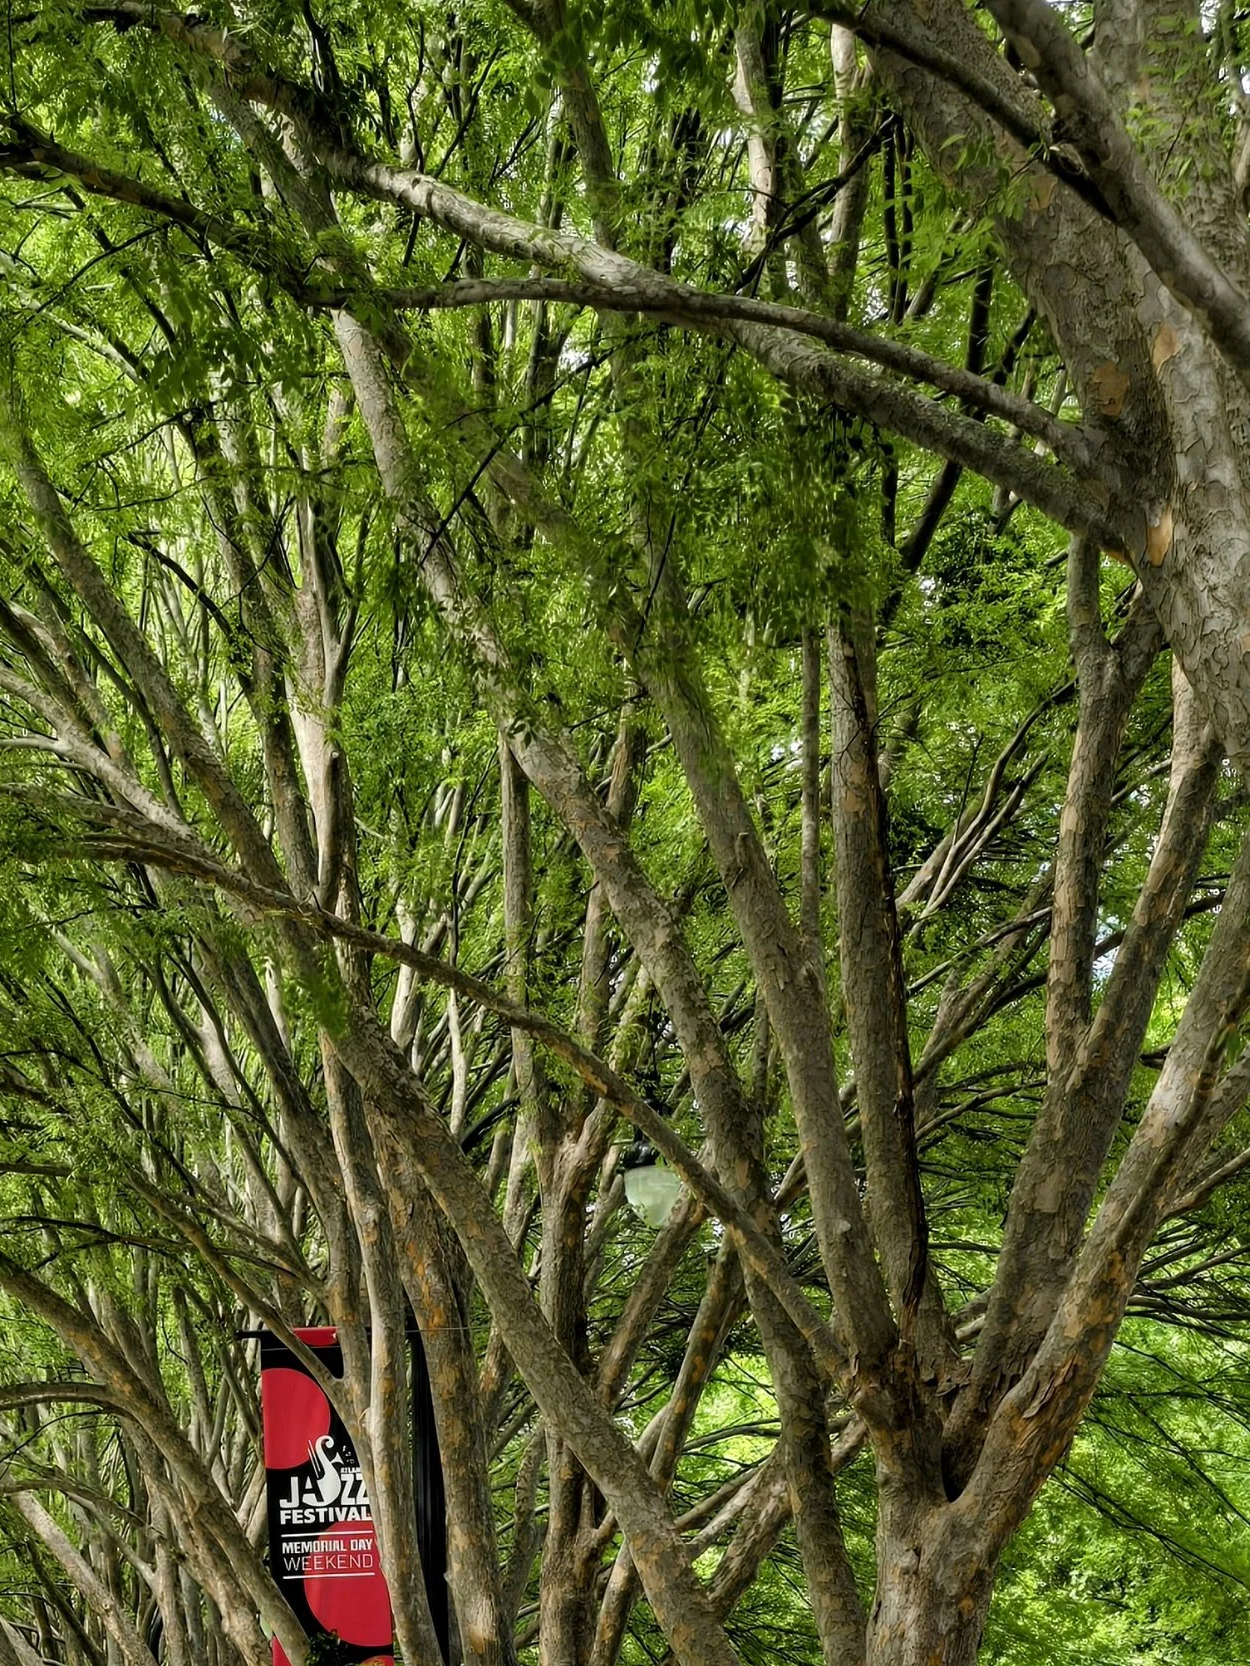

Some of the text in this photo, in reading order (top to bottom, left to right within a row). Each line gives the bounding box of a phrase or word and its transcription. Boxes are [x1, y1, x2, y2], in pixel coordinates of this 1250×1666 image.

[279, 1473, 370, 1508] JAZZ
[280, 1506, 373, 1525] FESTIVAL
[282, 1538, 373, 1554] MEMORIAL DAY
[283, 1553, 373, 1571] WEEKEND
